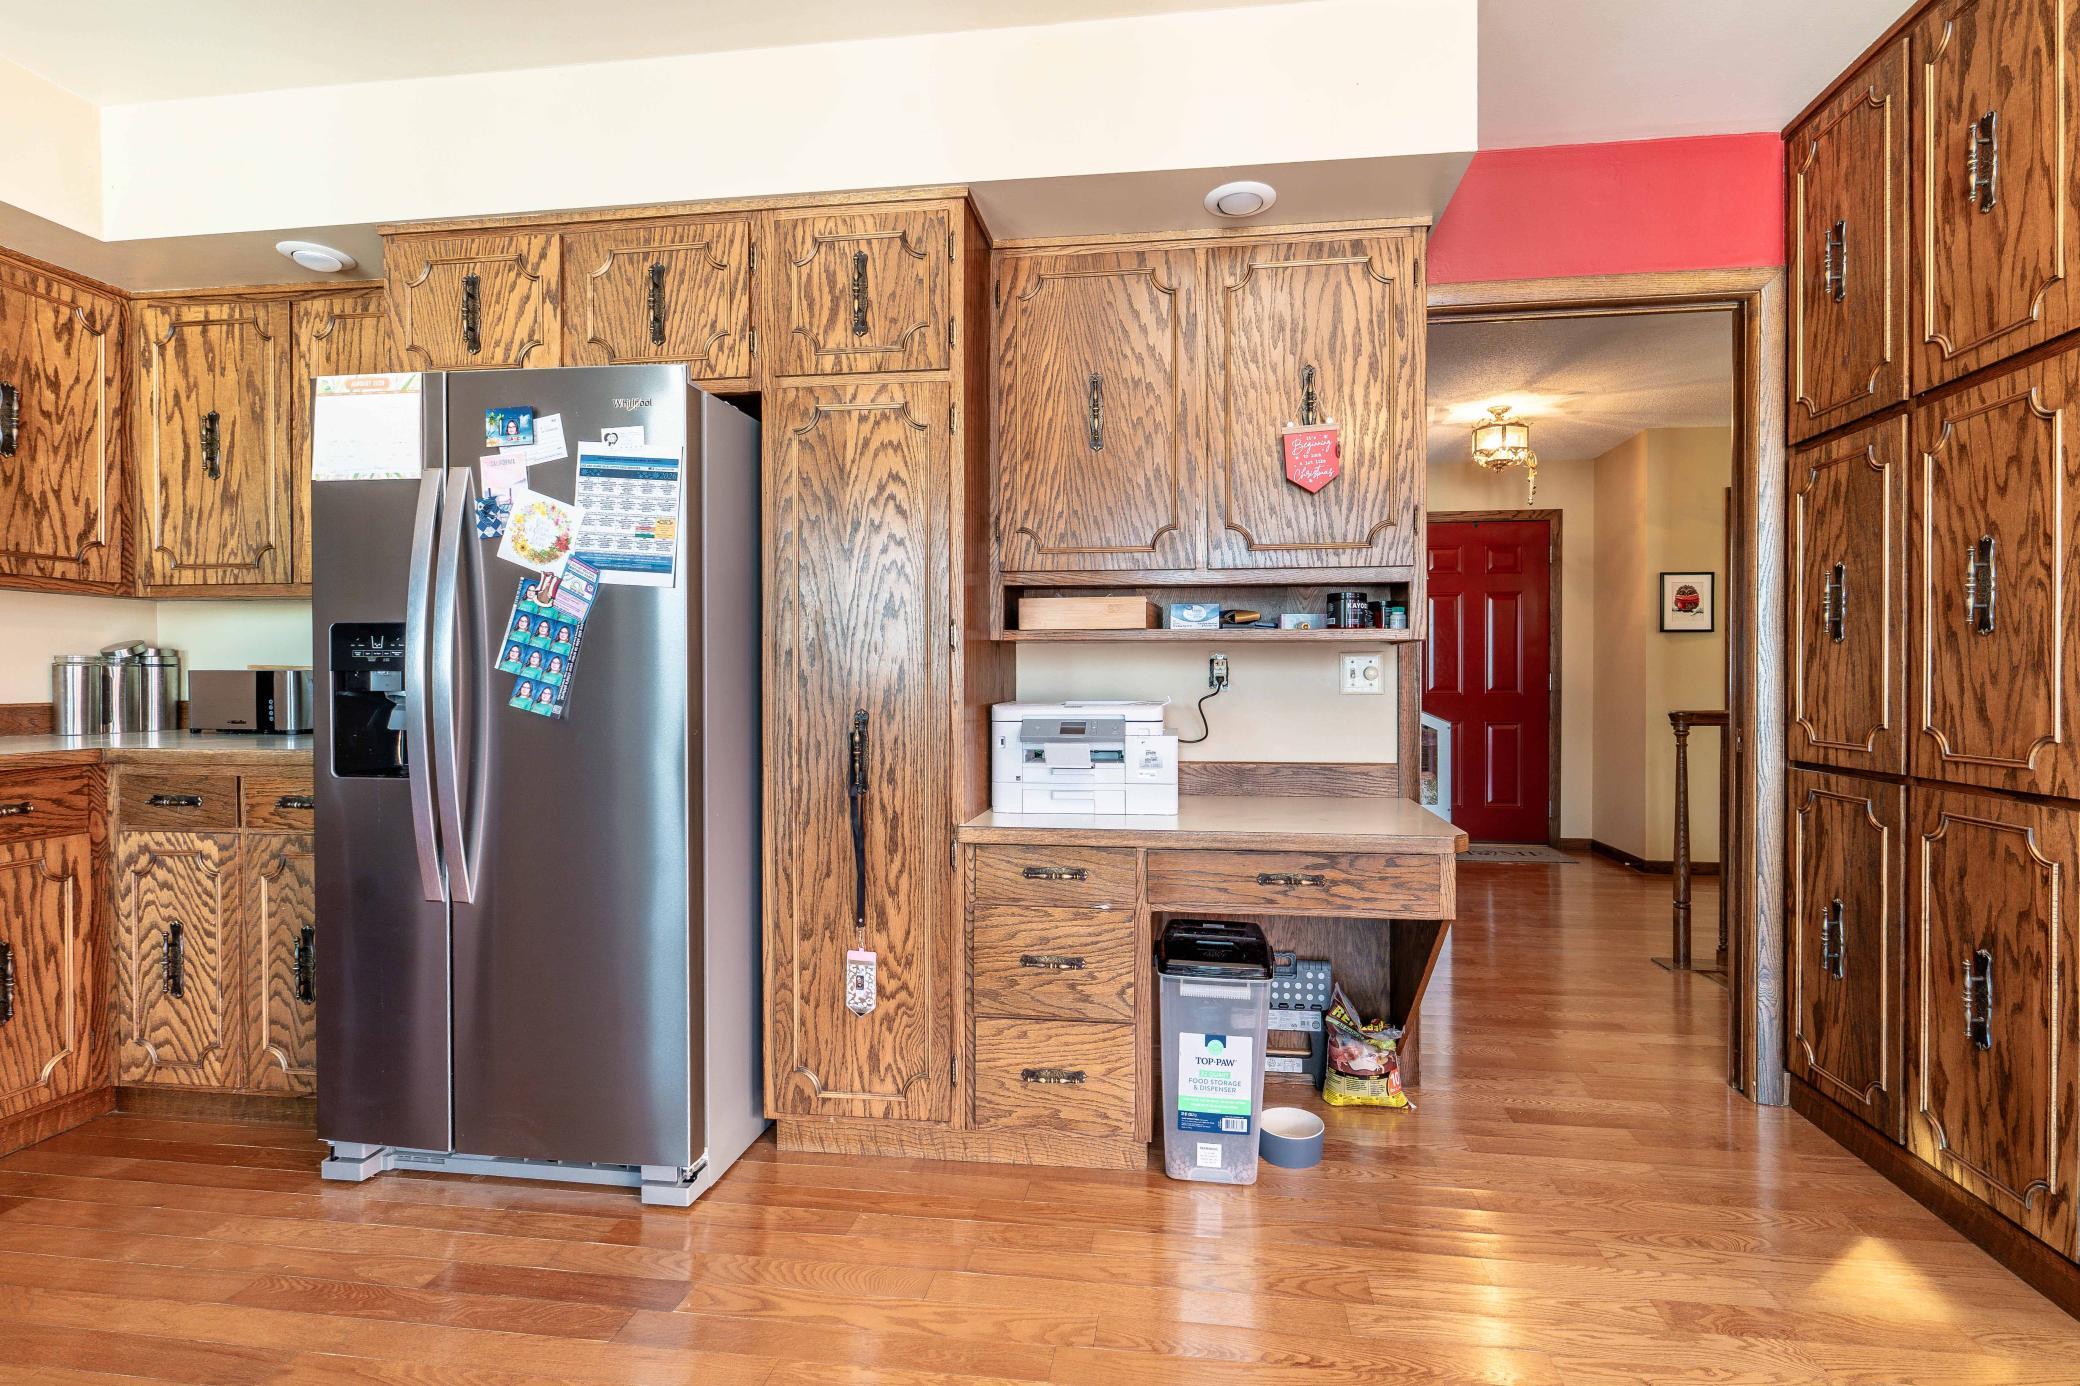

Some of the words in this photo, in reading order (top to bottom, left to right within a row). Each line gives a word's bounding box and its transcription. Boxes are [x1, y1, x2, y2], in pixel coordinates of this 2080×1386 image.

[612, 398, 653, 410] Whirlpool
[1292, 439, 1331, 456] Beginning
[1294, 465, 1335, 482] Christmas
